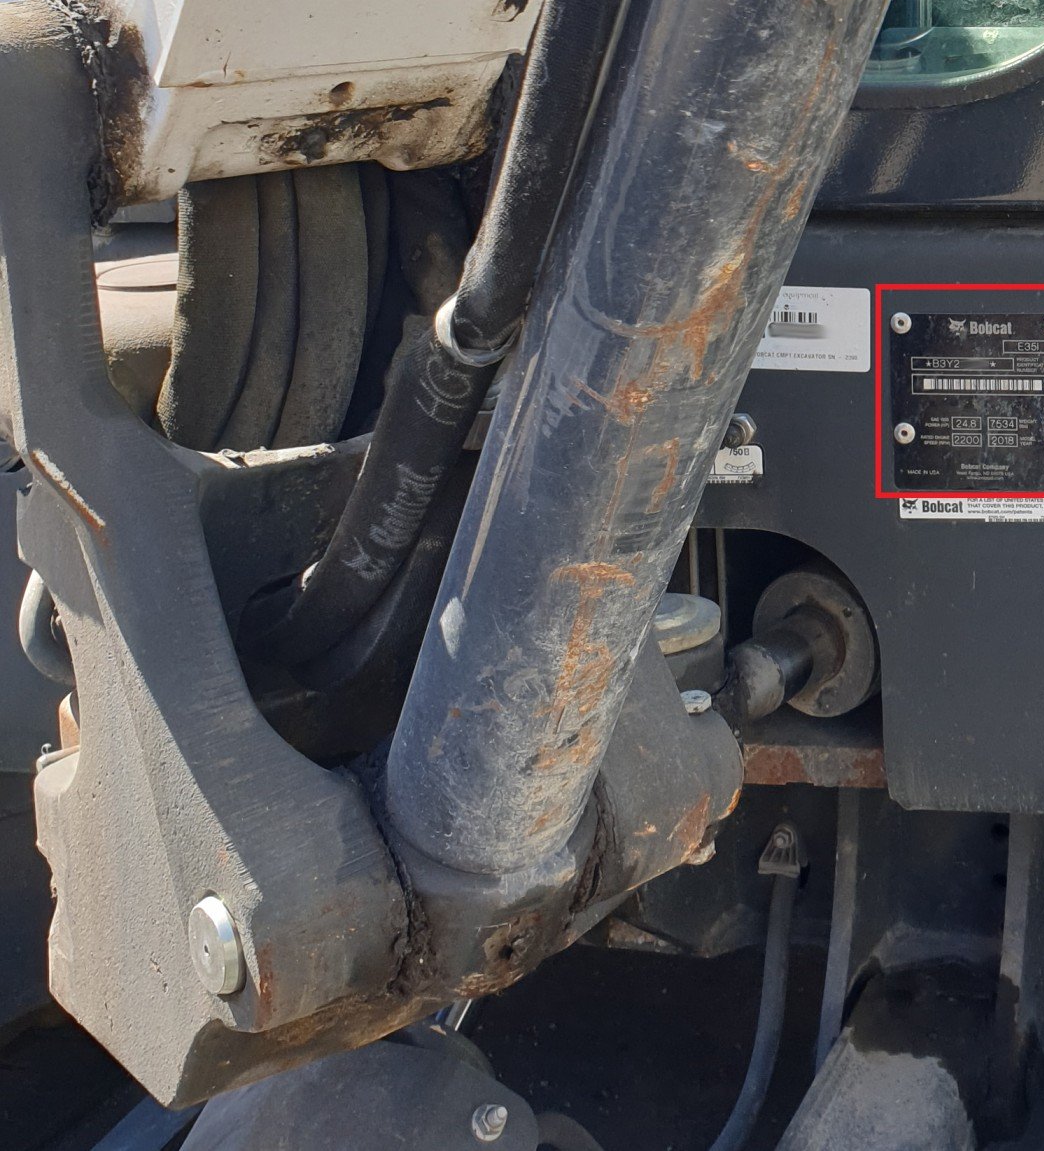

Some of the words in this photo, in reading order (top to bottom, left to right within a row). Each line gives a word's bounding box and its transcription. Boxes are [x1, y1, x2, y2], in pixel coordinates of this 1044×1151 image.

[970, 321, 1013, 335] Bobcat
[956, 419, 977, 428] 24.8
[990, 420, 1015, 429] 7534
[954, 436, 980, 445] 2200
[991, 436, 1014, 445] 2018
[922, 500, 964, 514] Bobcat
